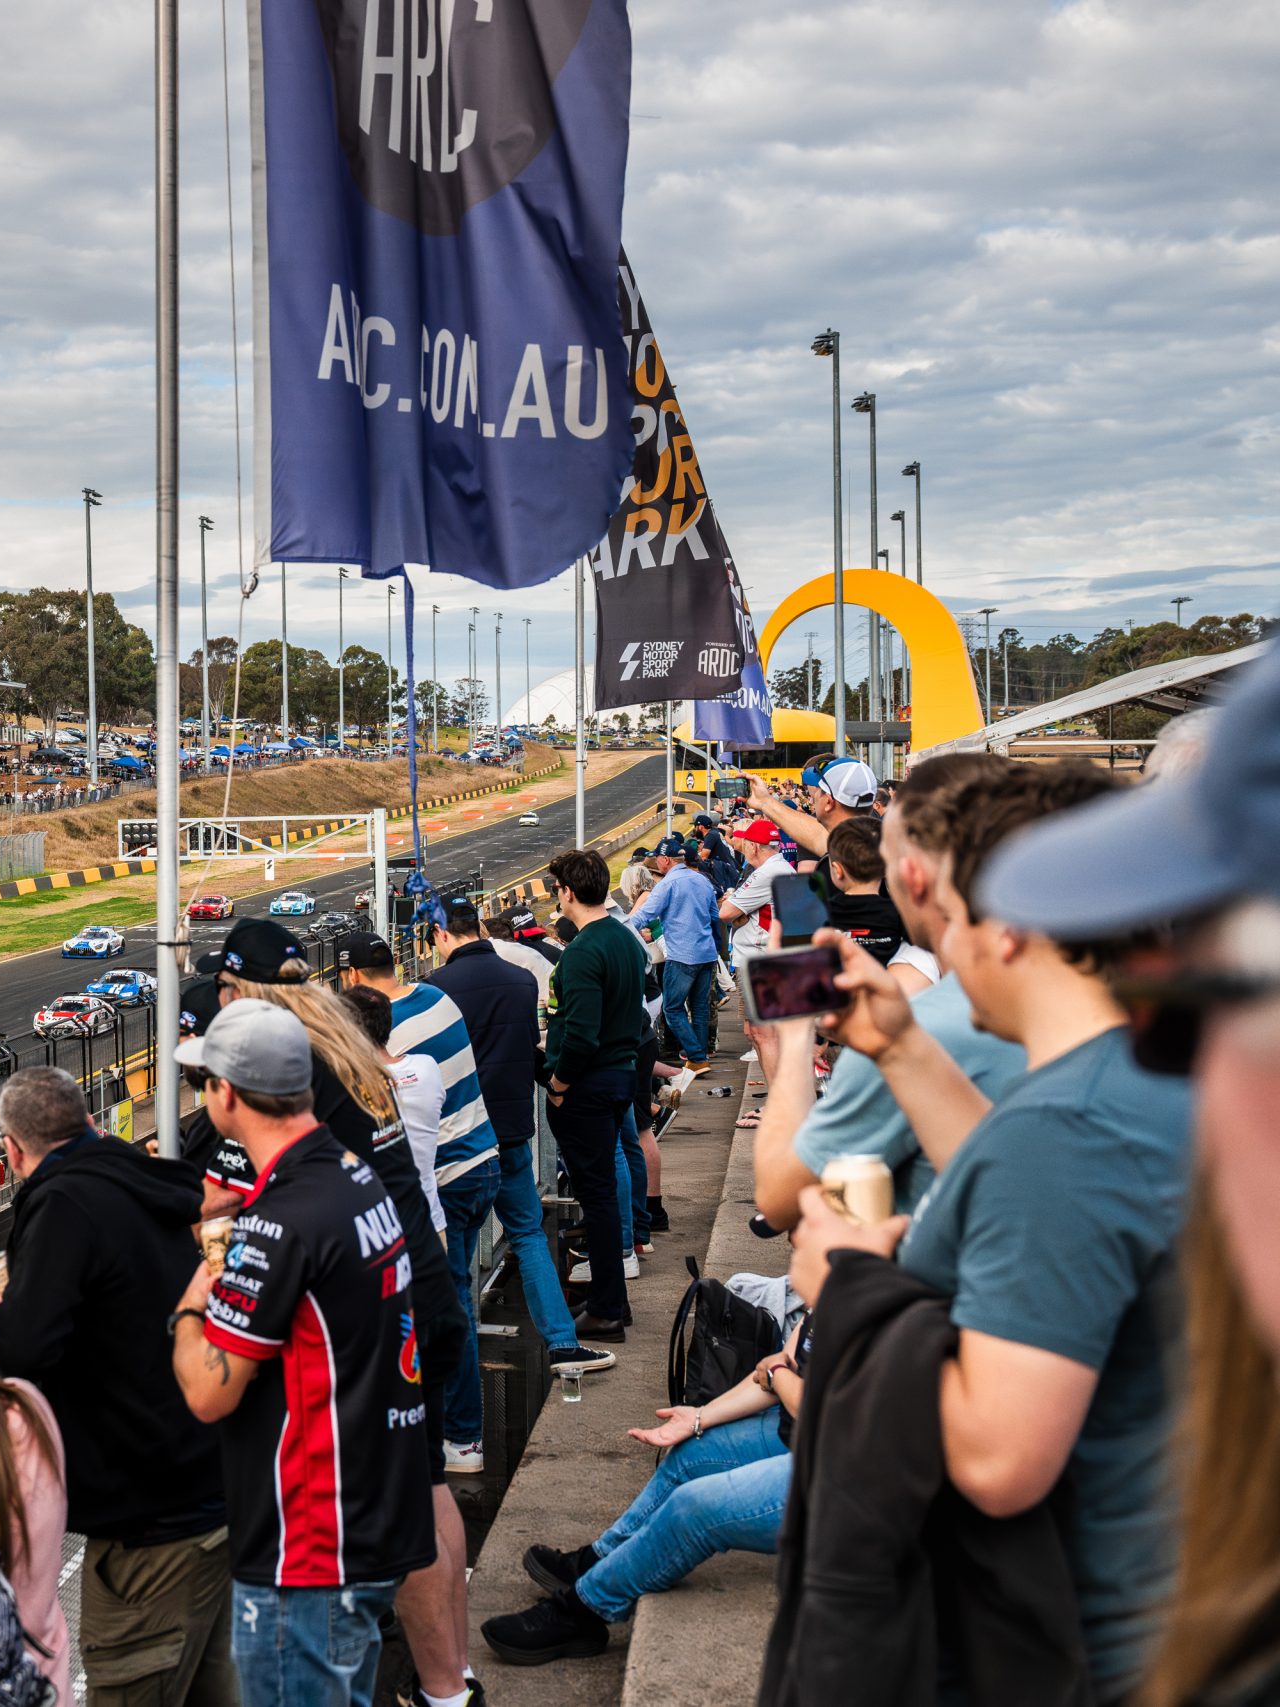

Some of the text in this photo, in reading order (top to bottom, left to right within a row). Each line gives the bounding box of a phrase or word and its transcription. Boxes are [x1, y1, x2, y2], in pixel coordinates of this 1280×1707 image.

[358, 0, 493, 172] ARC
[318, 283, 608, 440] AC.COM.AU
[586, 498, 710, 581] ARK
[642, 641, 685, 652] SYDNEY
[642, 649, 679, 661] MOTOR
[642, 658, 676, 670] SPORT
[642, 668, 670, 679] PARK
[697, 648, 740, 678] ARDC
[217, 1150, 247, 1171] APEX
